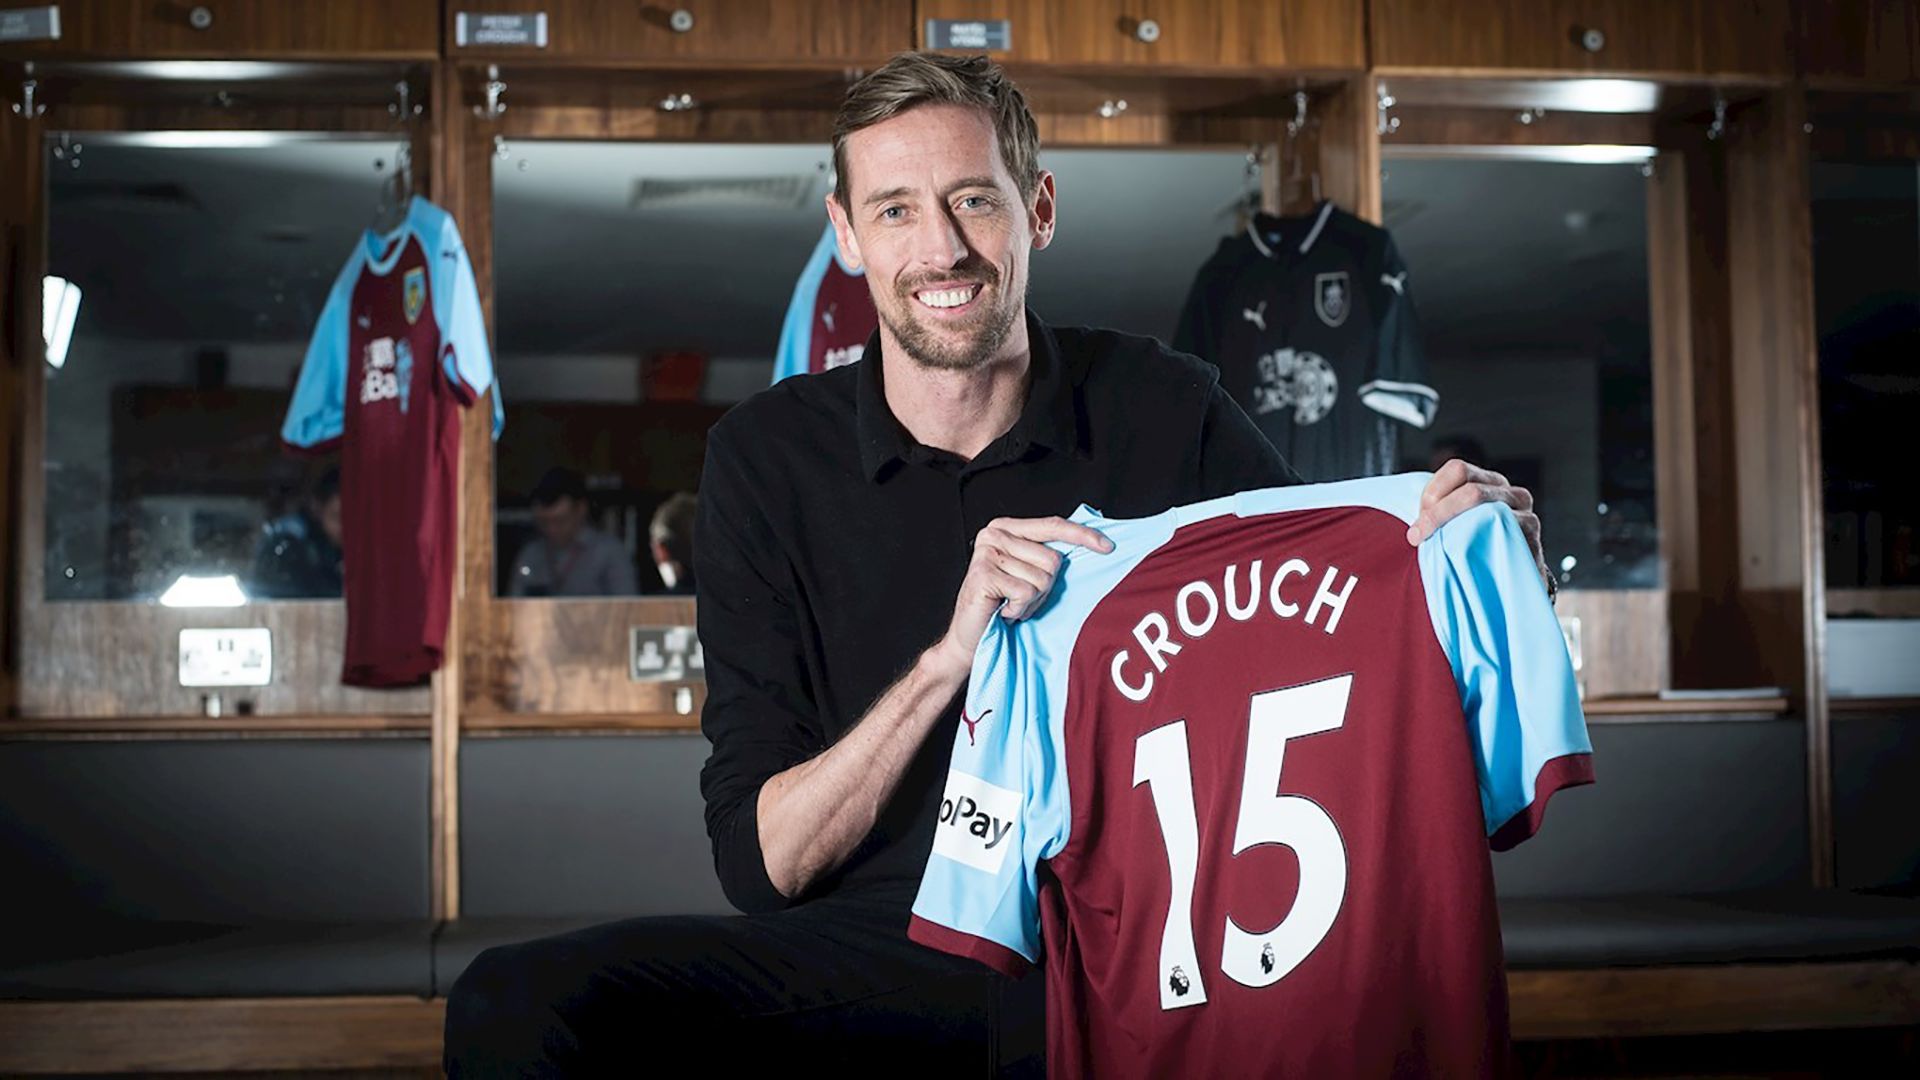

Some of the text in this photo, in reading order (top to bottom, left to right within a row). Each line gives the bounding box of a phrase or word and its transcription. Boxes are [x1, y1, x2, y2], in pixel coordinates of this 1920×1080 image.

[1110, 558, 1359, 702] CROUCH
[940, 795, 1013, 850] oPay
[1132, 672, 1354, 1011] 15
